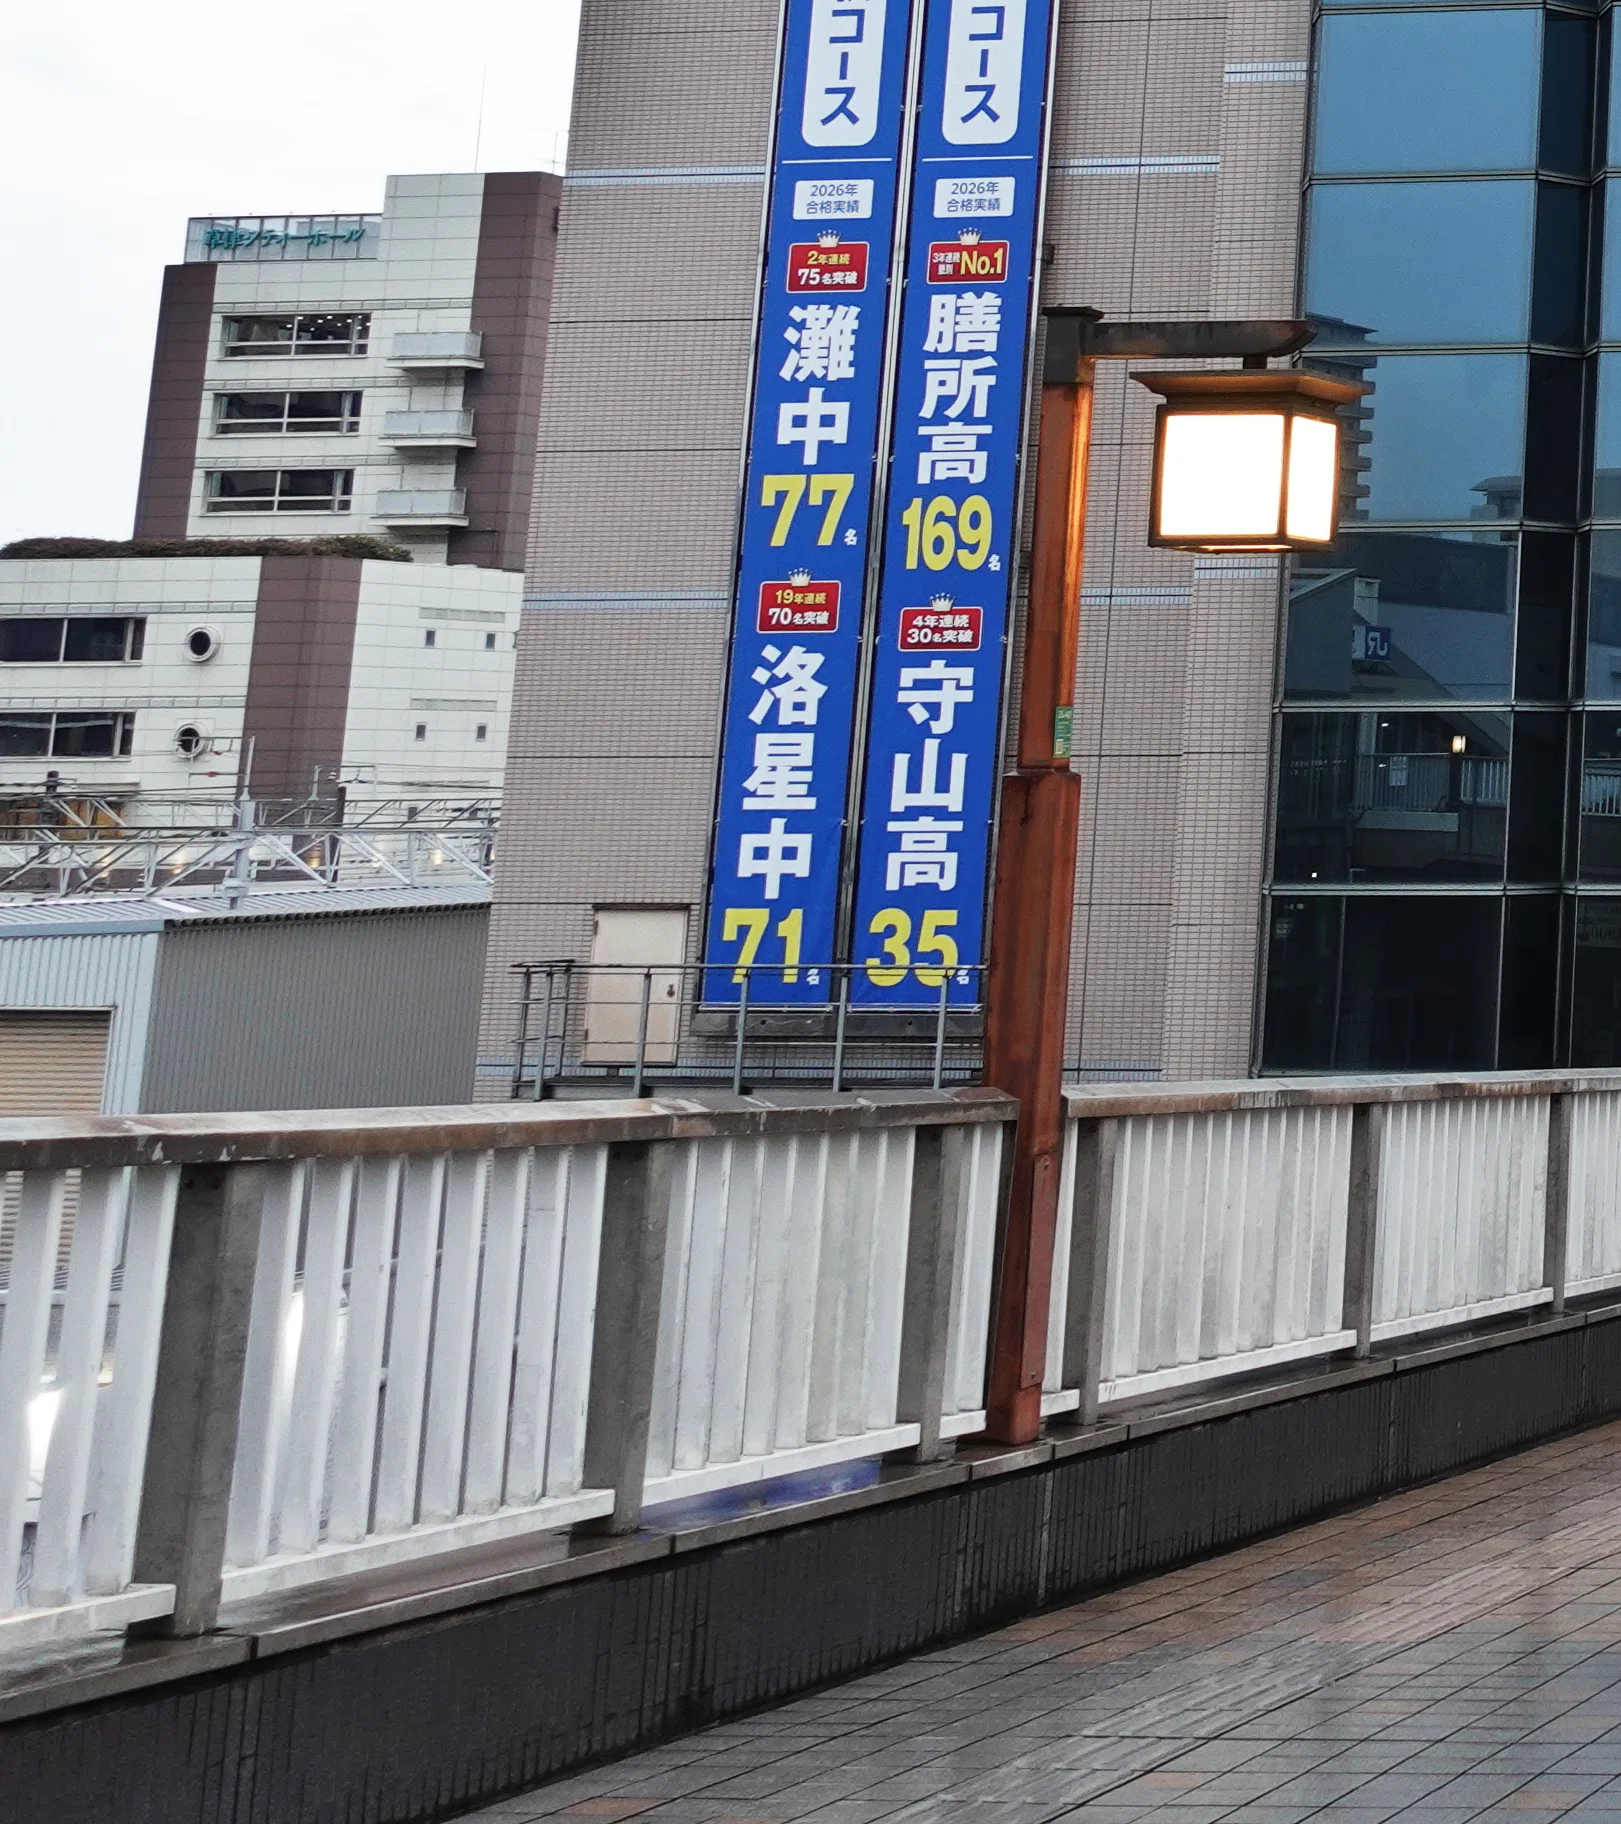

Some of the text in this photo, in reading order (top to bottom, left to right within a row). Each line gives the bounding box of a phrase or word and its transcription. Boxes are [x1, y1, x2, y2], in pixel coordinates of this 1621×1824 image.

[810, 184, 859, 197] 2026年
[951, 181, 1000, 195] 2026年
[805, 199, 861, 214] 合格実績
[946, 197, 1002, 212] 合格実績
[806, 250, 851, 266] 2年連続
[959, 247, 1004, 275] No.1
[797, 268, 858, 285] 75名突破
[776, 304, 862, 466] 灘中
[916, 290, 1002, 486] 膳所高
[775, 589, 827, 605] 19年連続
[768, 607, 829, 625] 70名突破
[912, 614, 969, 628] 4年連続
[906, 628, 973, 644] 30名突破
[735, 643, 829, 900] 洛星中
[885, 659, 975, 892] 守山高
